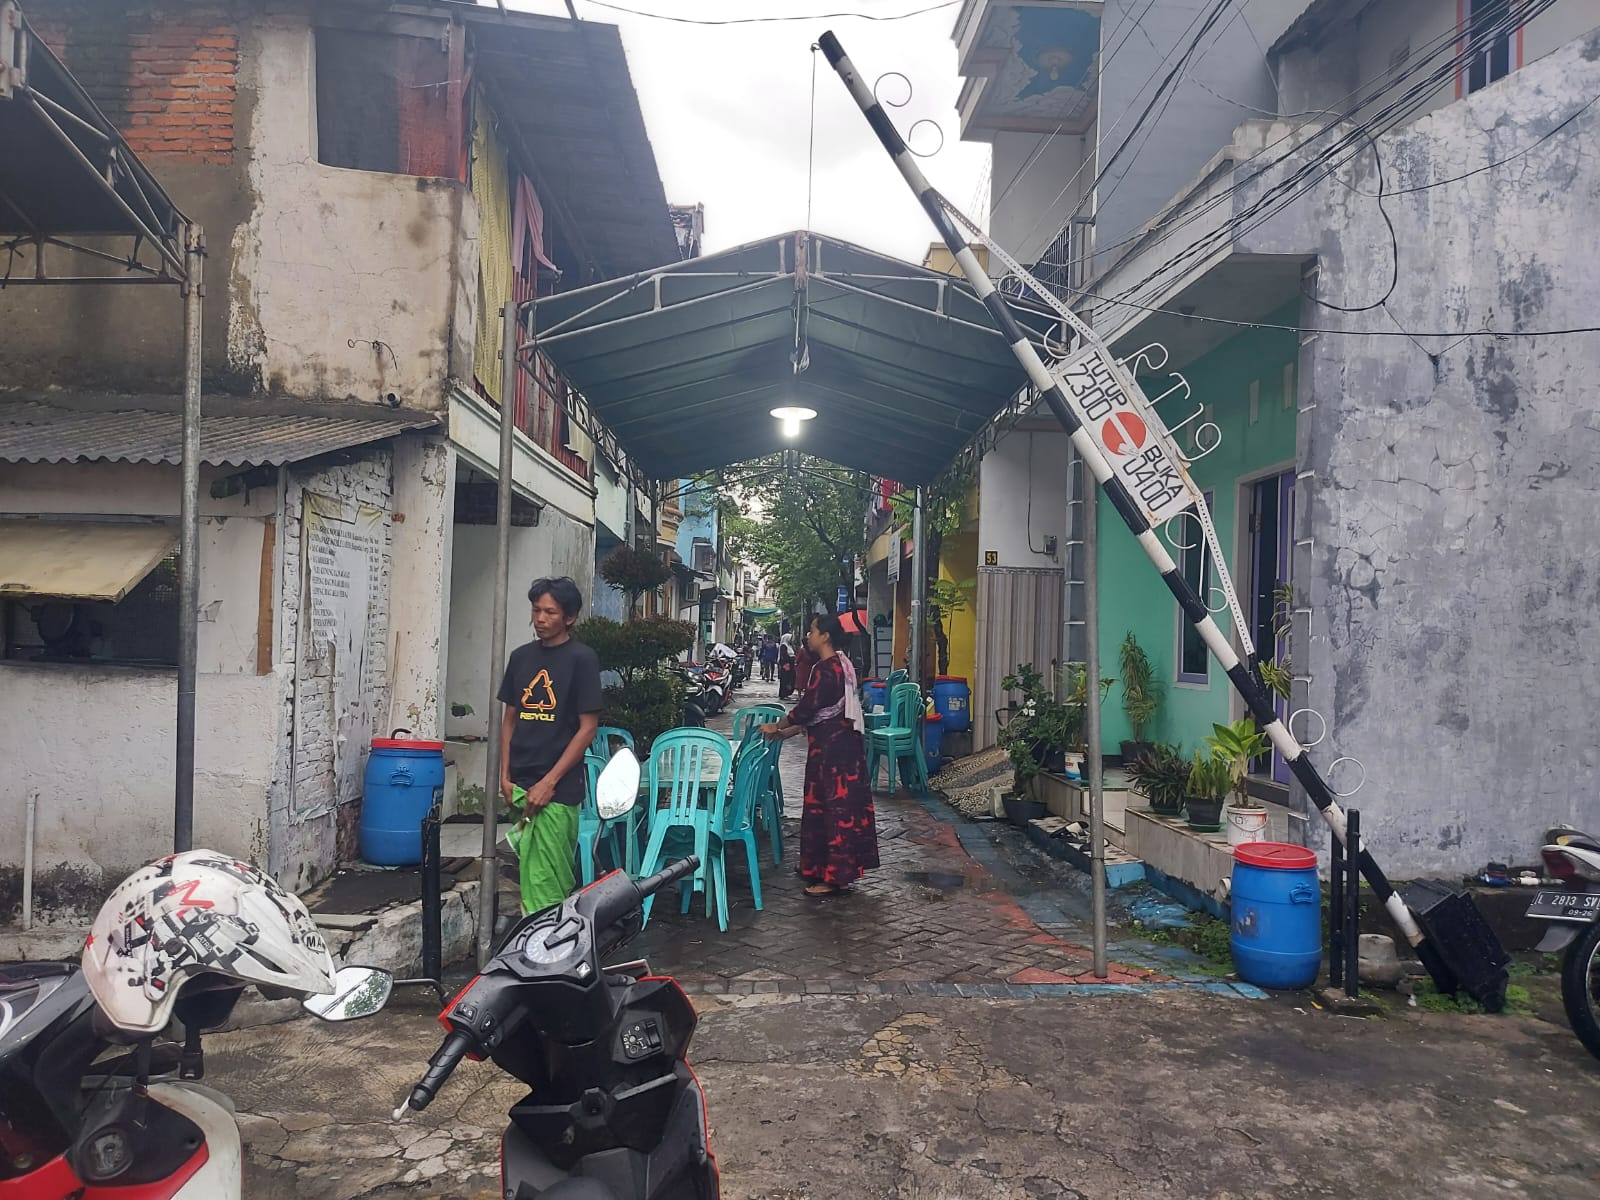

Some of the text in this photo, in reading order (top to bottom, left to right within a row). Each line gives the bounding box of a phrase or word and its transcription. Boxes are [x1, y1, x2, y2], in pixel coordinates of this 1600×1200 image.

[1063, 363, 1112, 422] 2300
[1085, 351, 1128, 406] TUTUP
[1122, 454, 1172, 512] 0400
[1144, 444, 1185, 498] BUKA
[986, 552, 997, 564] 53
[520, 711, 556, 722] RECYCLE
[1537, 894, 1544, 905] L
[1551, 895, 1577, 906] 2813
